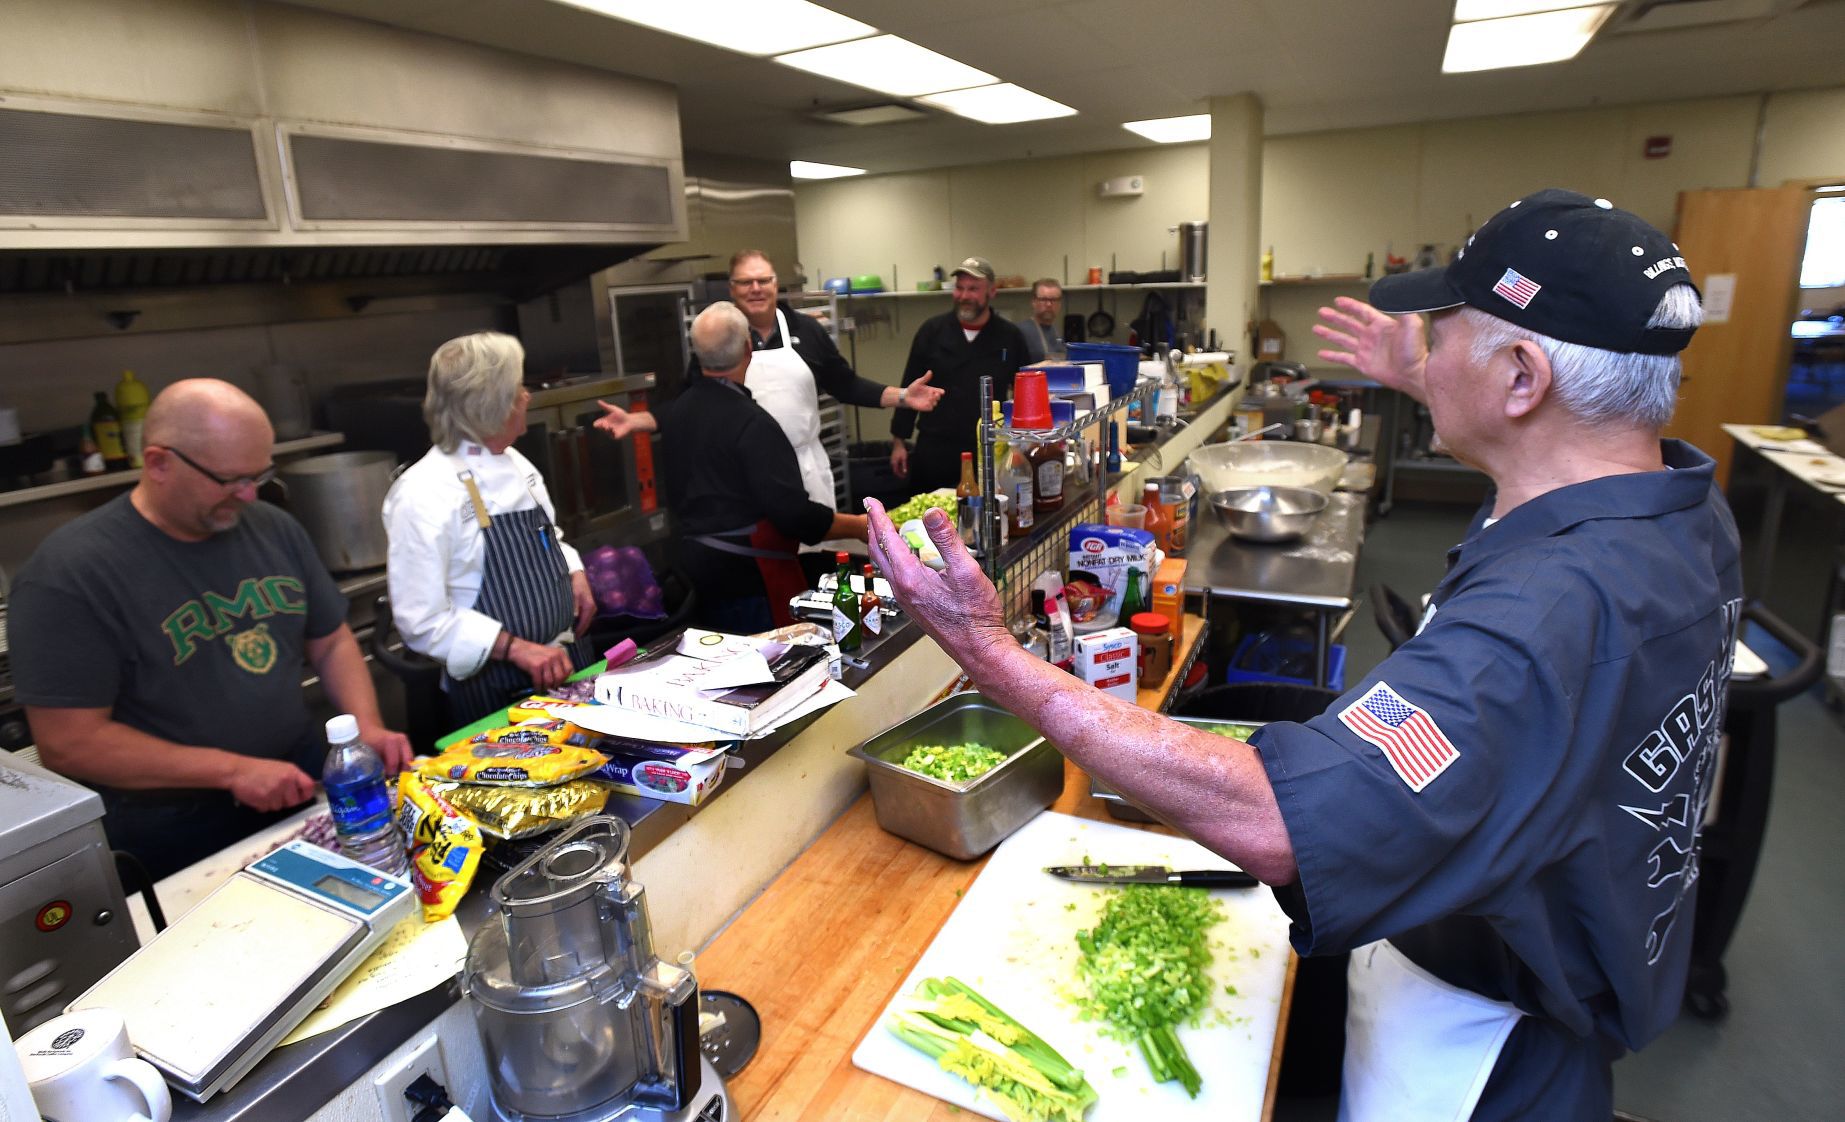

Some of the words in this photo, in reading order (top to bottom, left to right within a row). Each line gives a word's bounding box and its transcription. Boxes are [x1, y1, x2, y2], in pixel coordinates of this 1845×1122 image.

[1086, 542, 1103, 551] IGA
[1077, 557, 1106, 567] NONFAT
[1108, 556, 1125, 565] DRY
[1126, 553, 1146, 562] MILK
[161, 576, 306, 666] RMC
[1100, 650, 1125, 661] Classic
[1106, 662, 1120, 670] Salt
[631, 694, 694, 721] BAKING
[1622, 660, 1716, 793] GAS
[476, 771, 509, 781] Chocolate
[509, 771, 528, 781] Chips
[605, 763, 628, 777] Wrap
